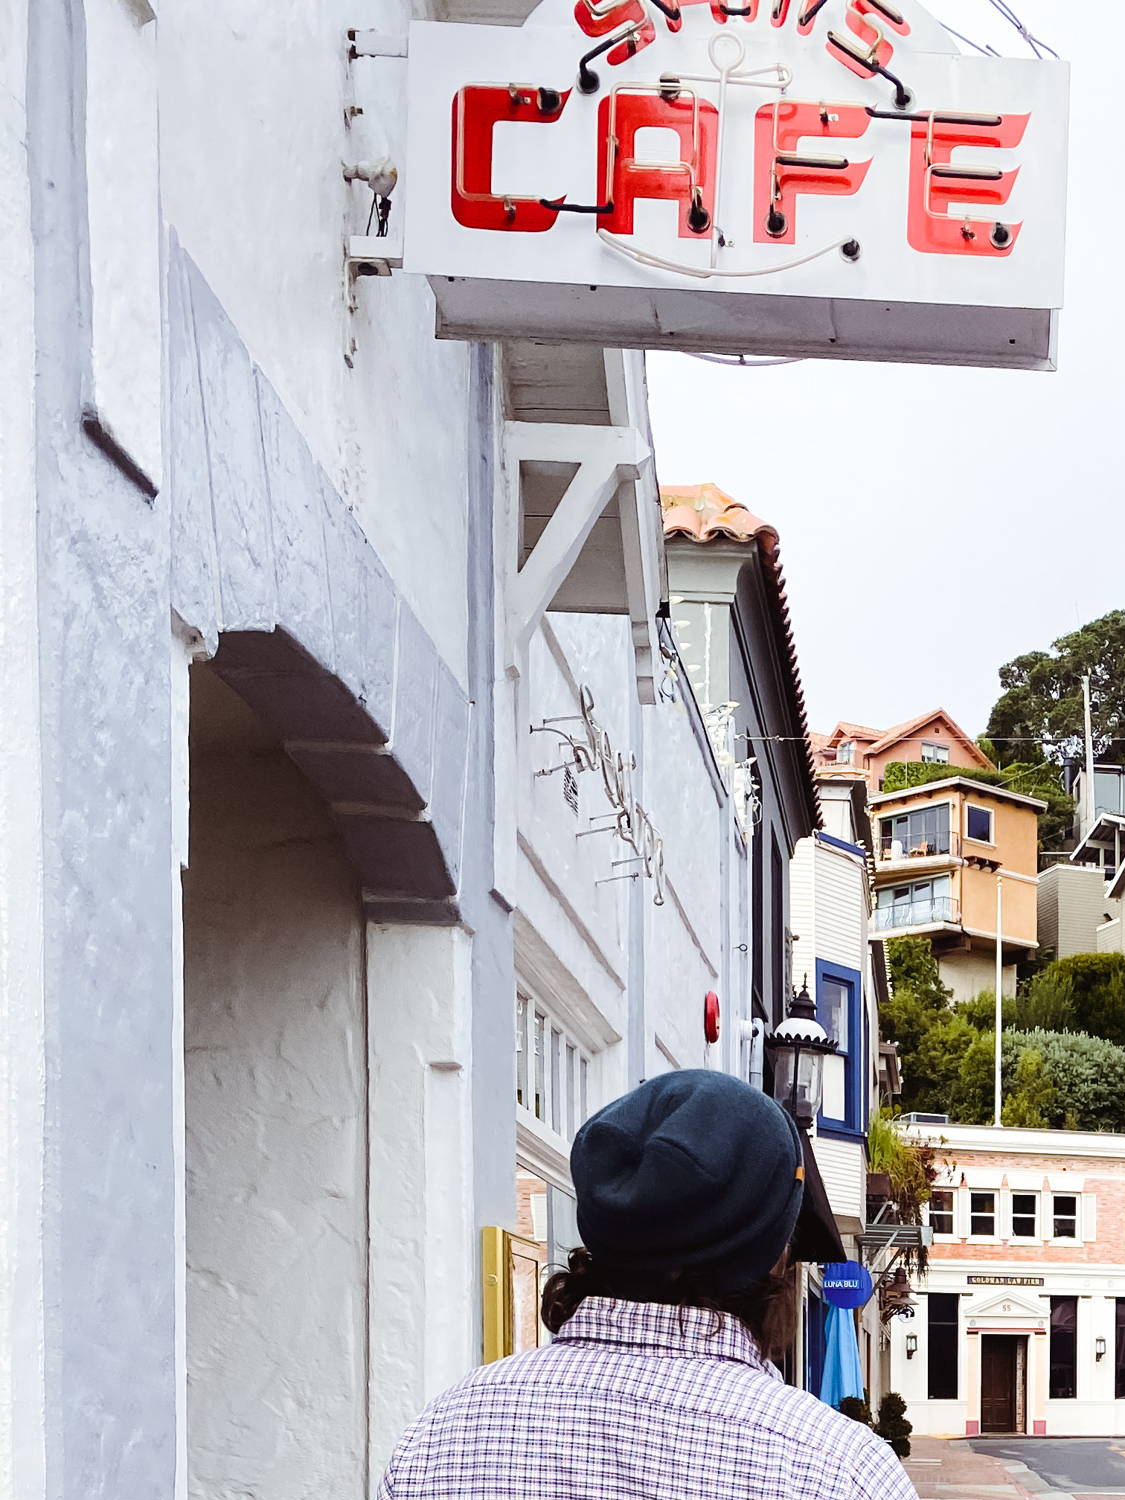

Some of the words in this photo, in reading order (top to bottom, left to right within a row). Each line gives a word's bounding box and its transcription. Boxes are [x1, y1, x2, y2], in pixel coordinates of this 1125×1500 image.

[451, 82, 1032, 256] CAFE
[824, 1280, 843, 1288] LUNA
[844, 1280, 858, 1288] BLU
